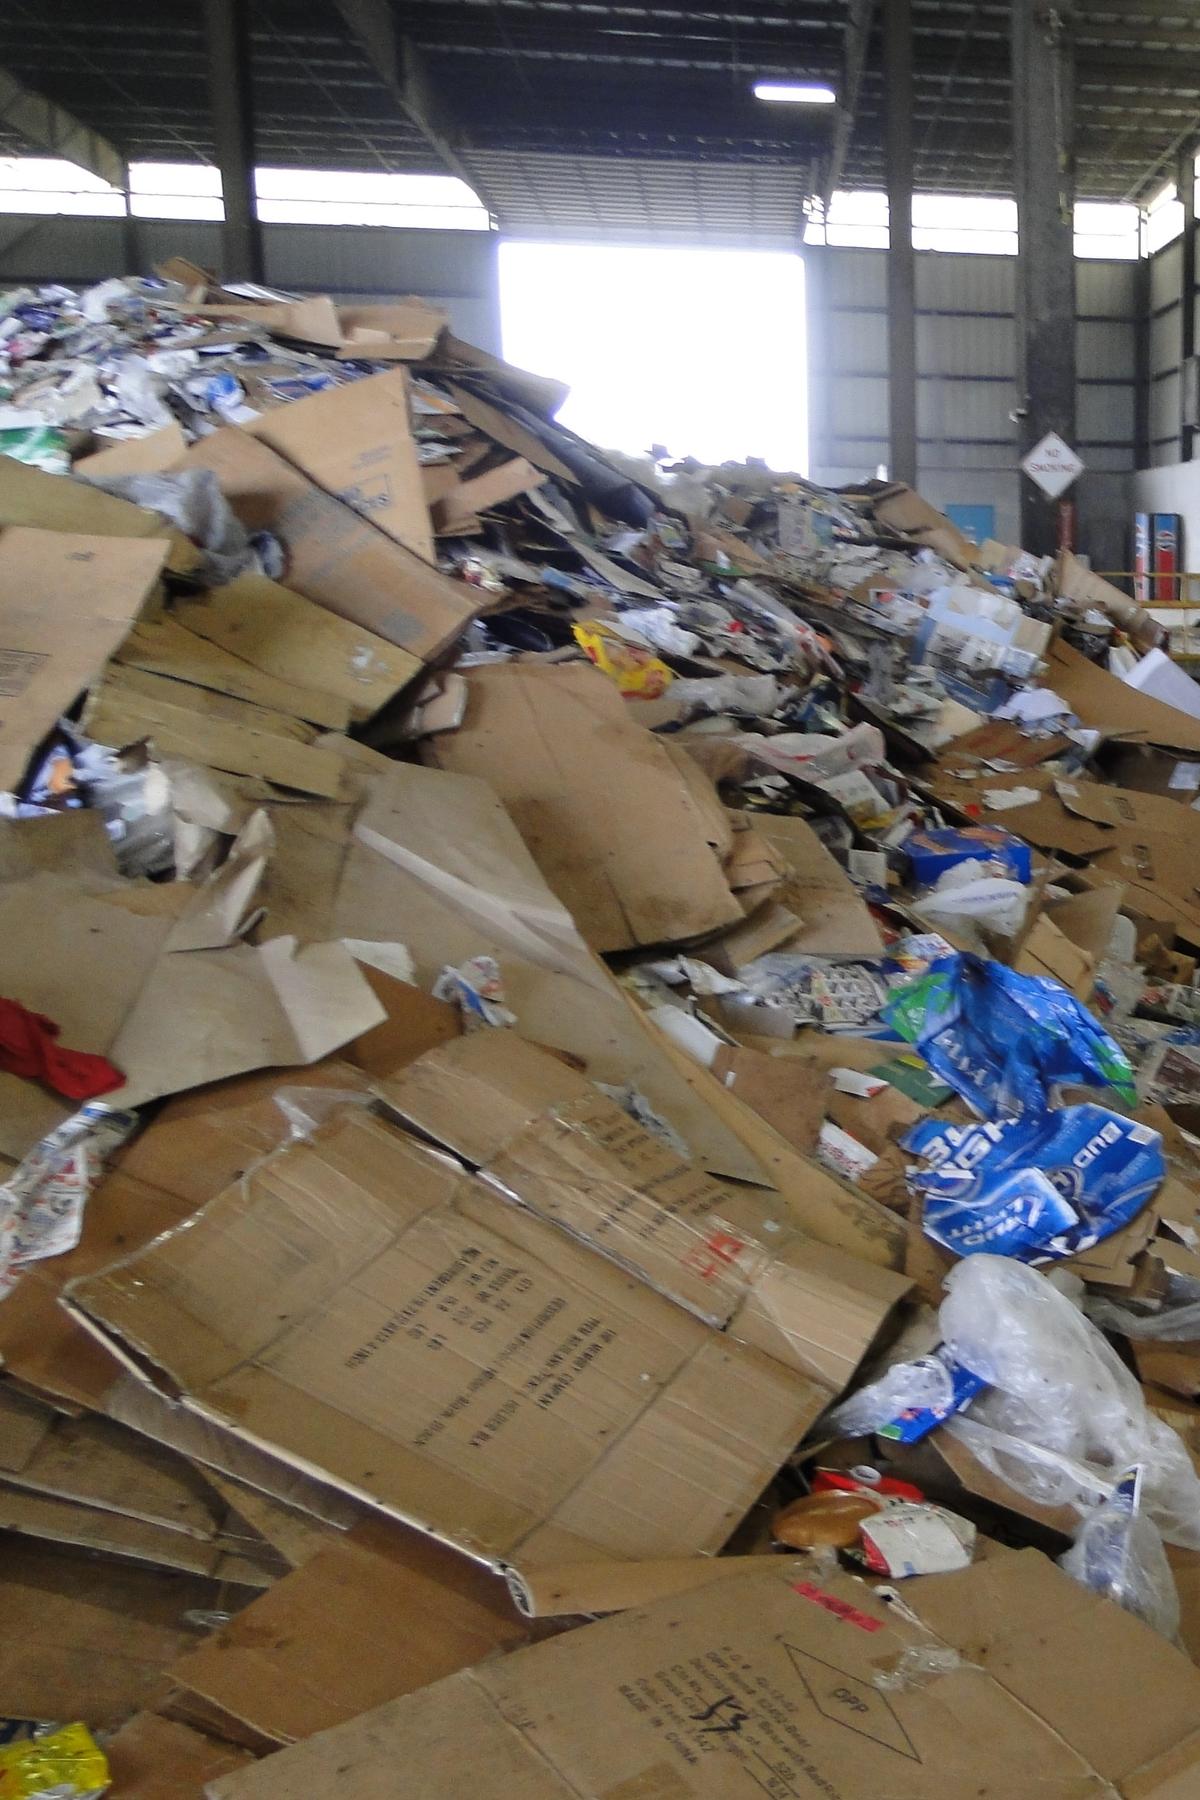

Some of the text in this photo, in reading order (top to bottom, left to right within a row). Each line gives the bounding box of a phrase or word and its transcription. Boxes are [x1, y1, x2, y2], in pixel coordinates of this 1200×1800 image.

[1045, 449, 1059, 458] NO
[1030, 463, 1073, 473] SMOKING
[1072, 1121, 1123, 1168] BUD
[832, 1688, 869, 1713] OPP
[663, 1732, 699, 1765] CHINA
